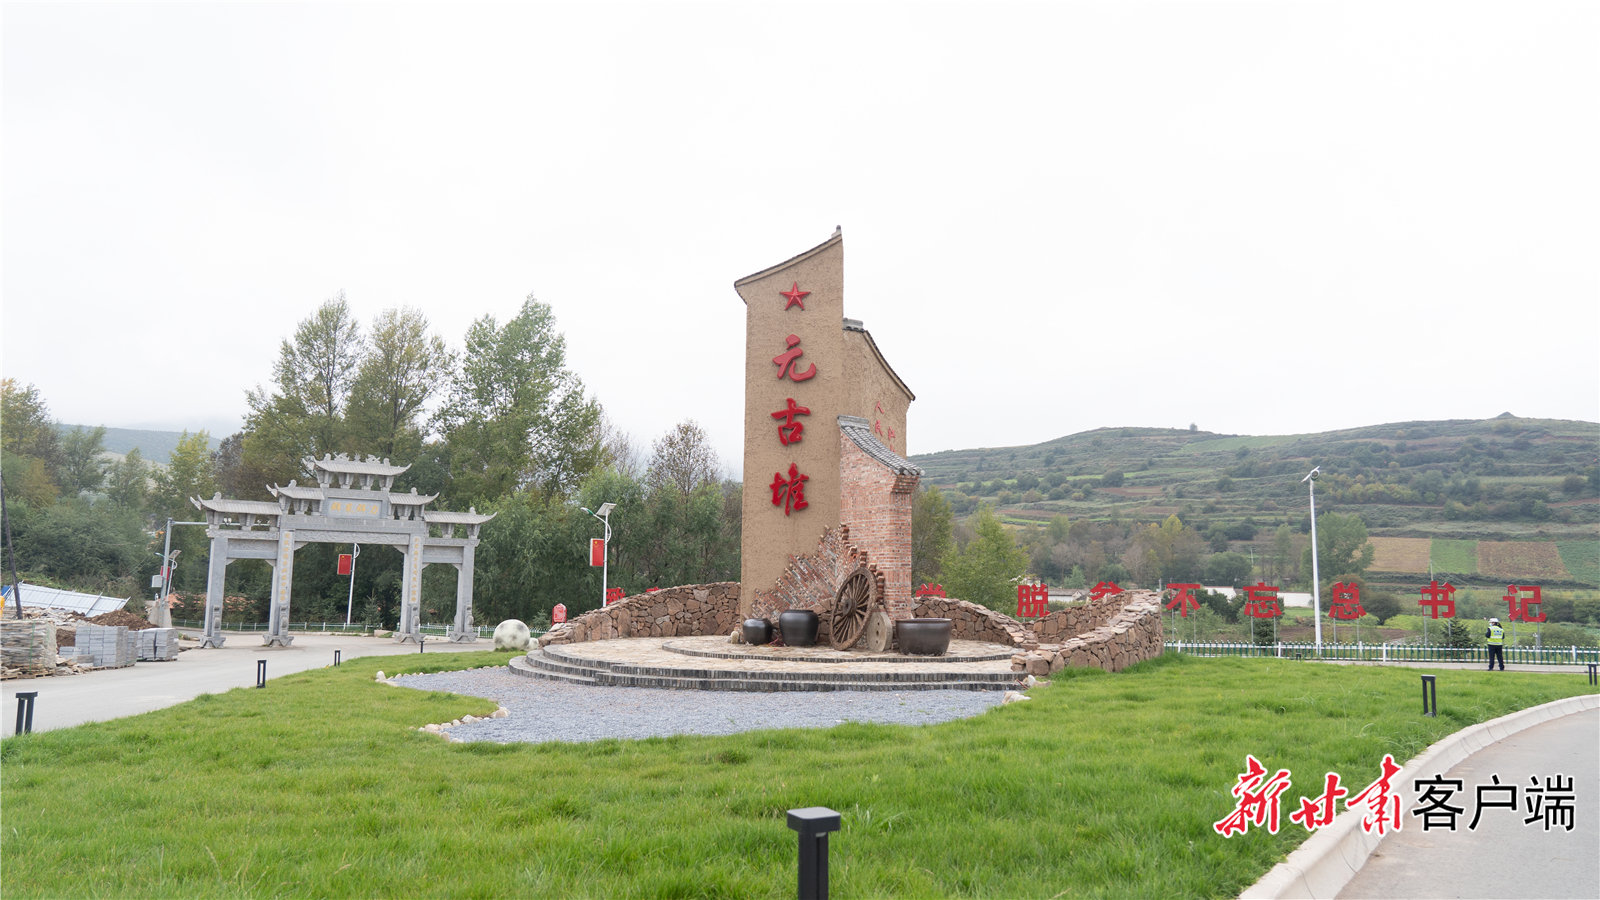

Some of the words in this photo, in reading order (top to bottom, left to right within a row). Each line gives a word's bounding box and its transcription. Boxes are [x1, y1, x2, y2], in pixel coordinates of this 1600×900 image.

[769, 333, 817, 516] 元古堆
[1016, 580, 1547, 623] 脱贫不忘总书记
